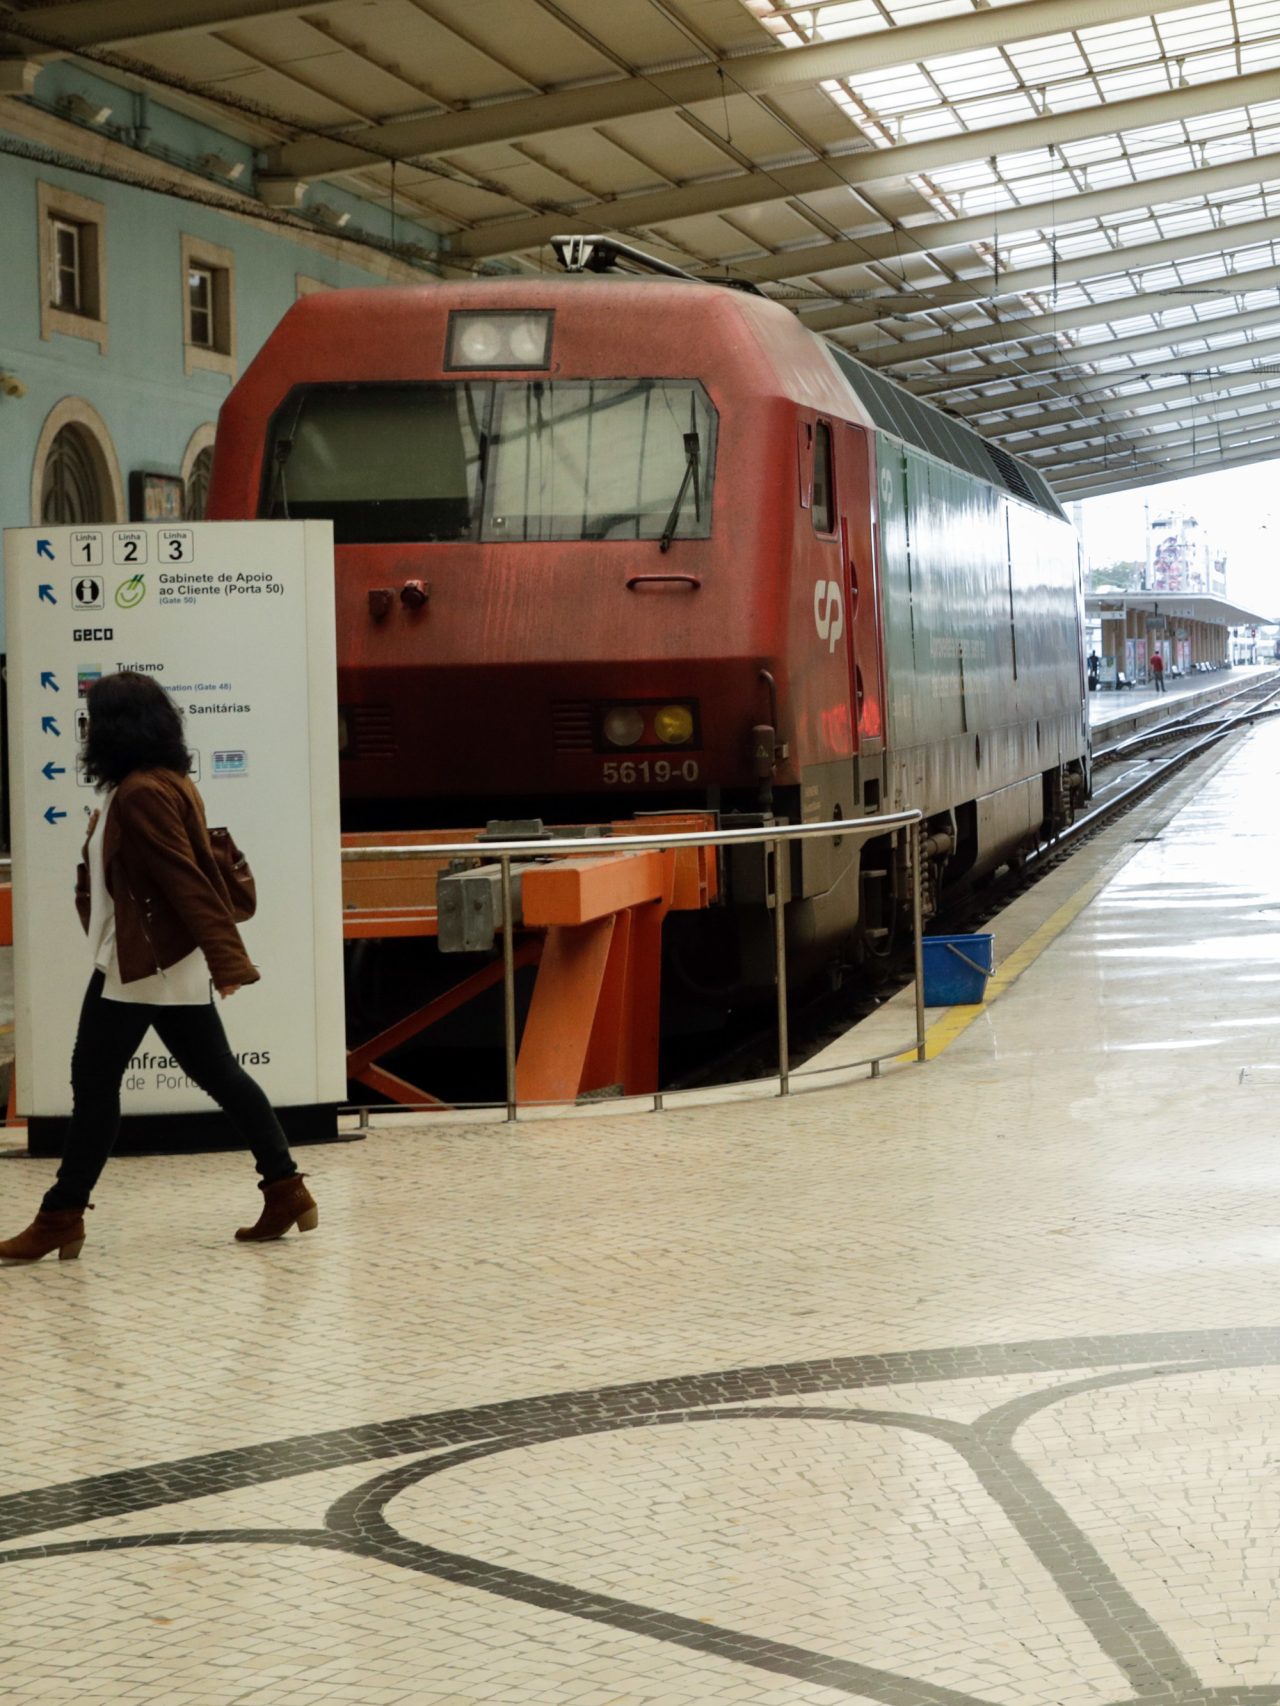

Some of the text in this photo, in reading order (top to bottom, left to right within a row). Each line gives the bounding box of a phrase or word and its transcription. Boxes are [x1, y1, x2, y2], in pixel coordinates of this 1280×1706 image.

[75, 533, 97, 541] Linha
[118, 532, 141, 541] Linha
[163, 530, 188, 540] Linha
[81, 542, 92, 562] 1
[123, 541, 138, 562] 2
[168, 540, 184, 560] 3
[158, 572, 273, 585] Gabinete de Apoio
[159, 583, 285, 597] ao Cliente (Porta 50)
[116, 662, 164, 672] Turismo
[194, 684, 216, 692] (Gate
[189, 703, 251, 715] Sanitárias
[602, 760, 698, 784] 5619-0
[126, 1075, 145, 1090] de
